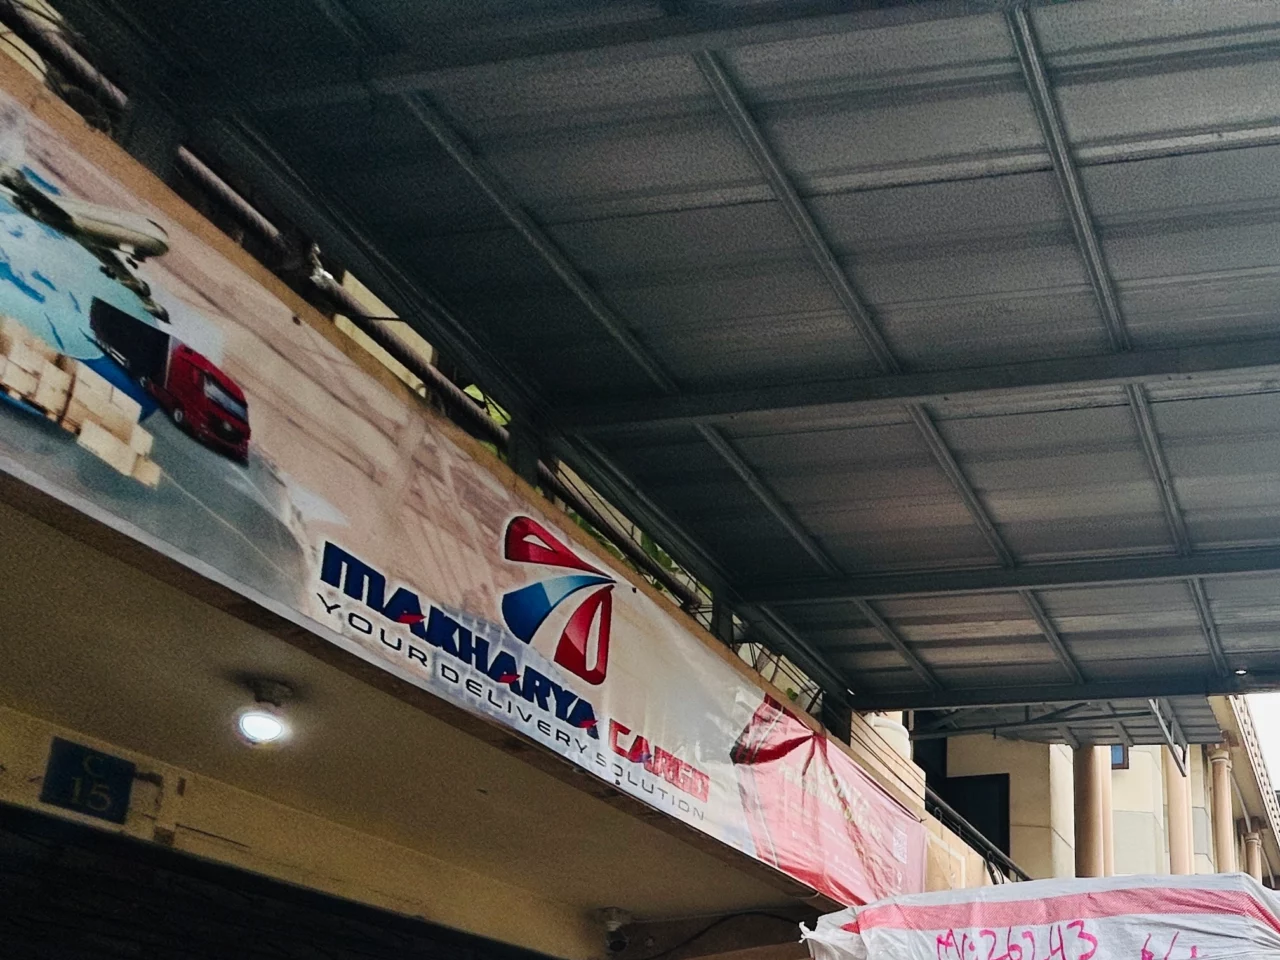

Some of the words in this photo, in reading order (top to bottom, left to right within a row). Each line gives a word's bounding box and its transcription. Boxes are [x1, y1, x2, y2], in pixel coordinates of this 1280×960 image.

[316, 592, 428, 668] YOUR
[441, 665, 589, 754] DELIVERY
[595, 752, 705, 821] SOLUTION
[319, 540, 600, 740] MAKHARYA
[609, 717, 711, 803] CARGO
[71, 776, 112, 811] 15
